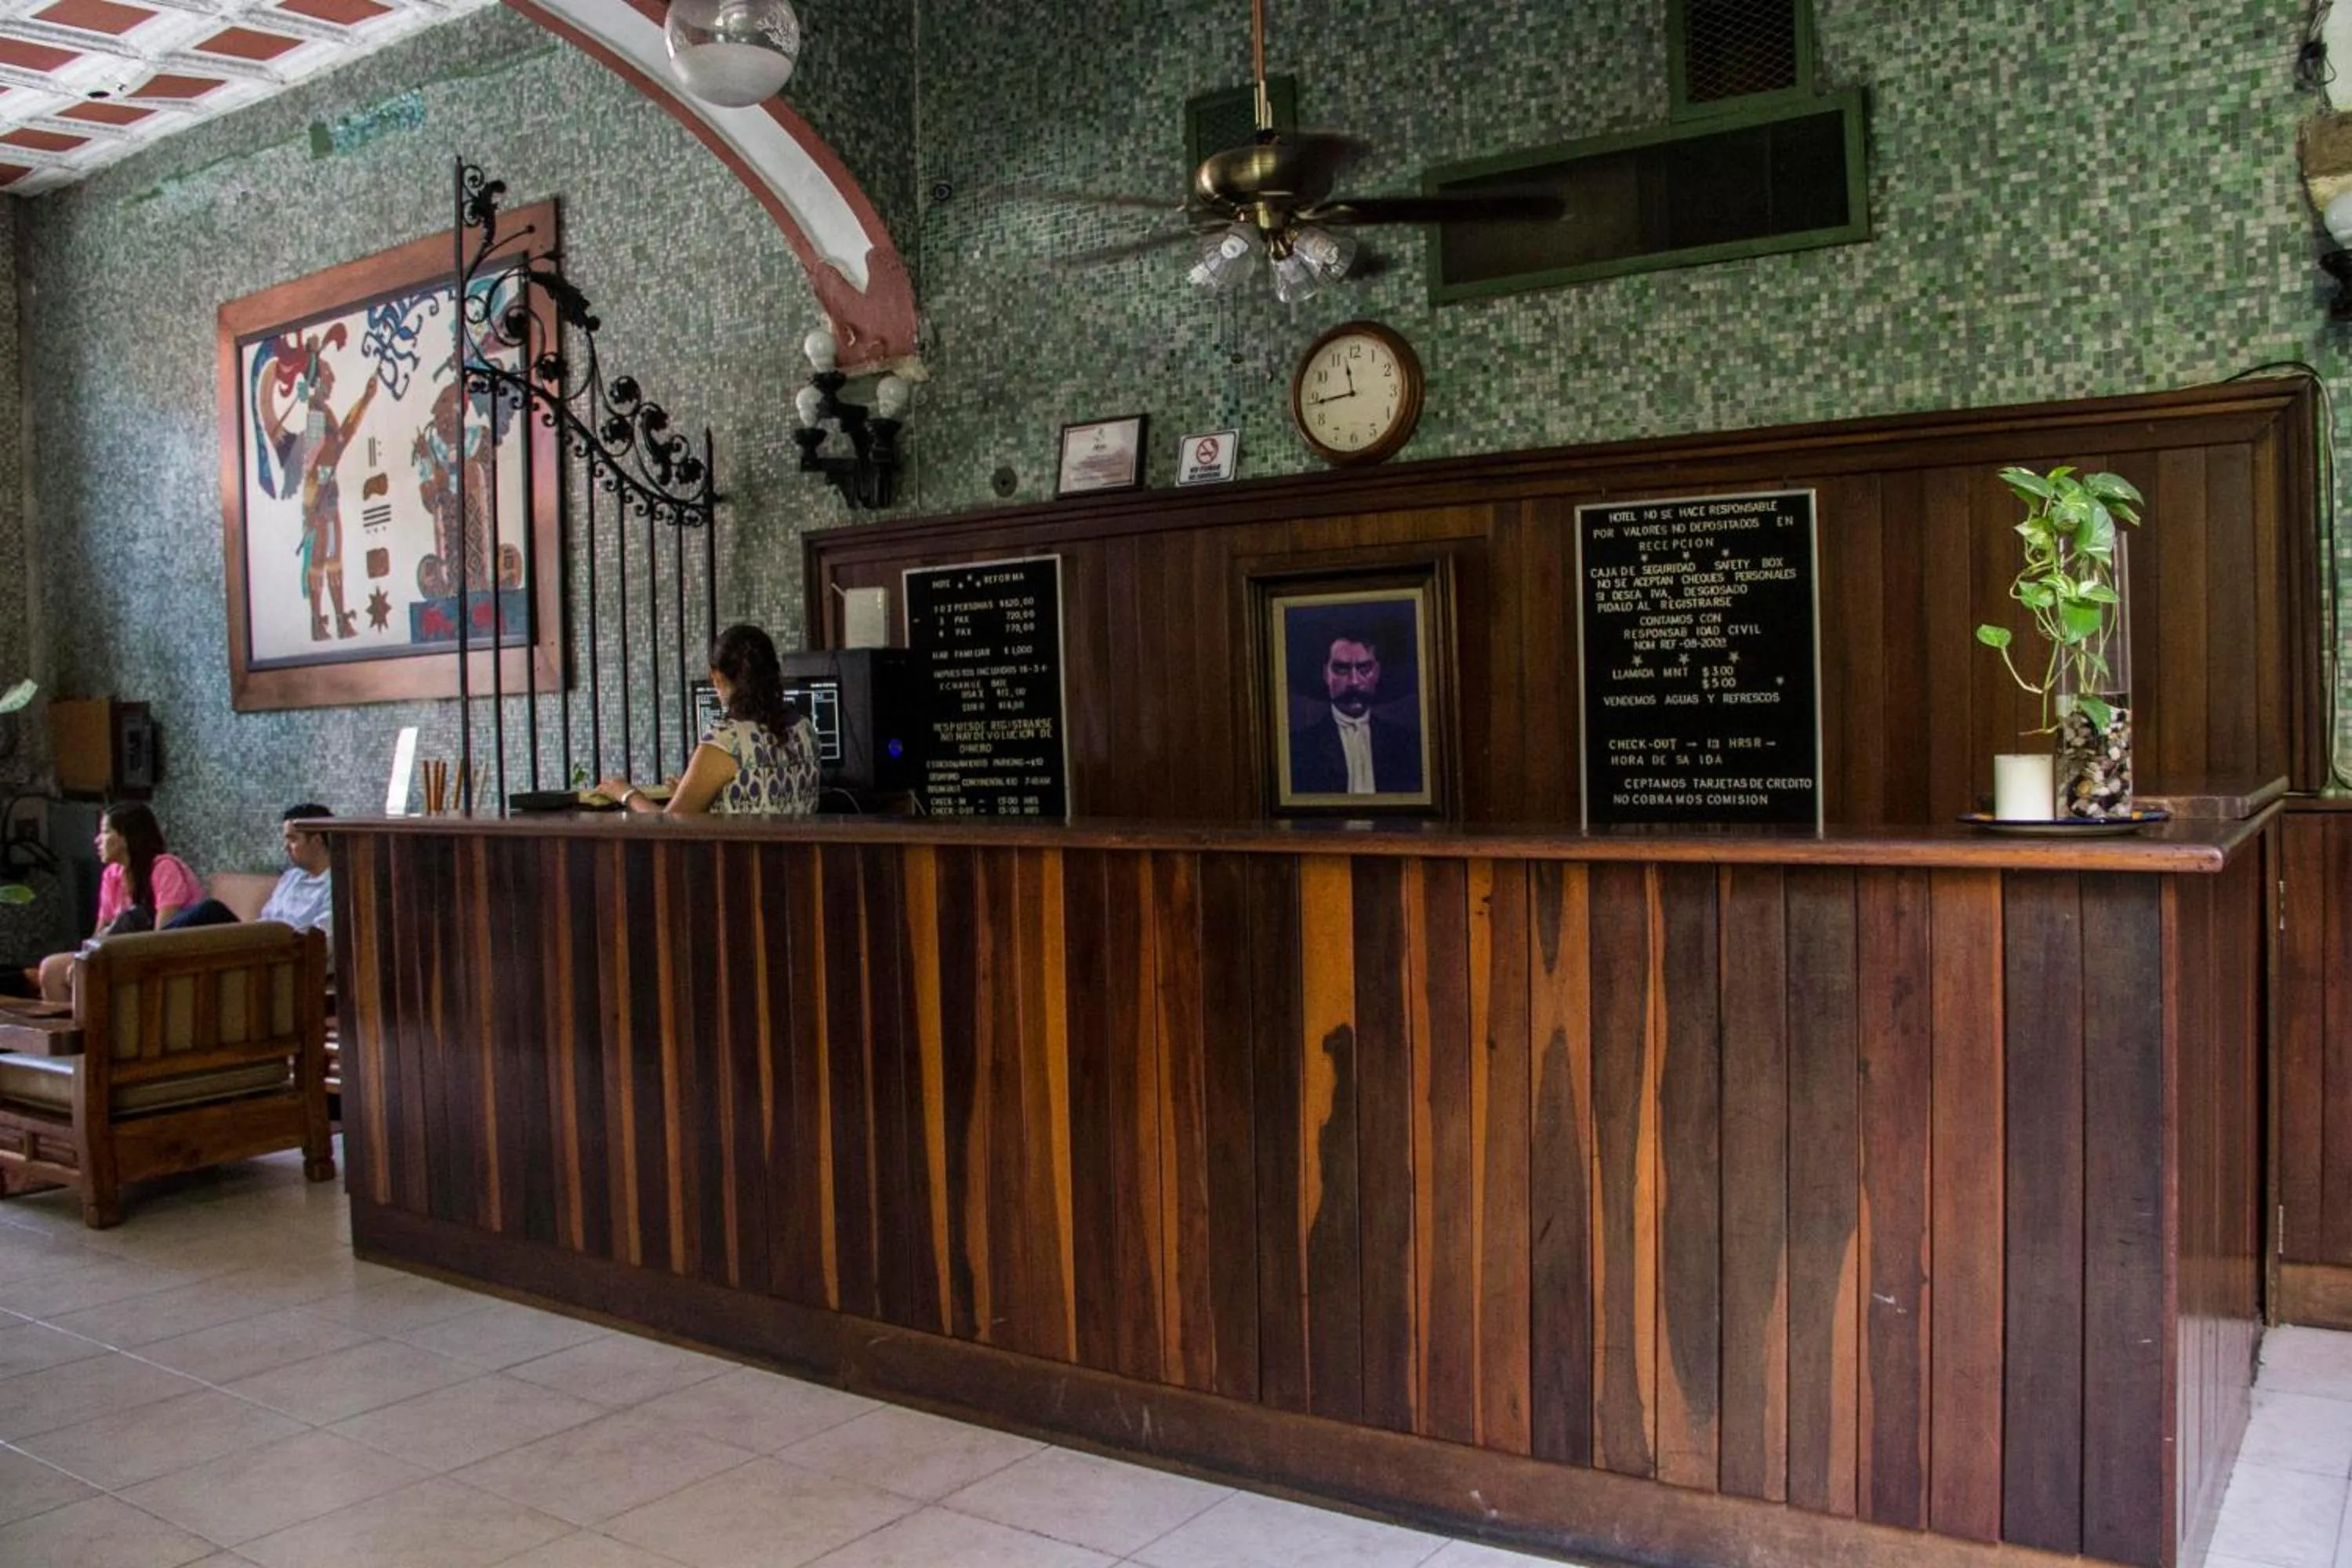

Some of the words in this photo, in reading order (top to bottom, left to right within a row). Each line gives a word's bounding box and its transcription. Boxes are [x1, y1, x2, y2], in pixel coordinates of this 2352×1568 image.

[1348, 343, 1362, 359] 12
[1331, 353, 1341, 368] 11
[1383, 363, 1392, 378] 2
[1389, 383, 1399, 398] 3
[1317, 412, 1327, 427] 8
[1349, 431, 1359, 445] 6
[1608, 511, 1637, 523] HOTEL
[1643, 509, 1657, 520] NO
[1661, 508, 1673, 519] SE
[1679, 506, 1706, 517] HACE
[1708, 500, 1778, 515] RESPONSABLE
[1592, 528, 1614, 539] POR
[1623, 524, 1668, 537] VALORES
[1671, 522, 1686, 534] NO
[1690, 517, 1760, 532] DEPOSITADOS
[1777, 515, 1794, 528] EN
[1639, 537, 1714, 551] RECEPCION
[1590, 568, 1617, 578] CAJA
[1621, 565, 1636, 576] DE
[1642, 561, 1696, 575] SEGURIDAD
[1714, 559, 1751, 570] SAFETY
[1762, 557, 1784, 568] BOX
[1597, 579, 1611, 590] NO
[1614, 577, 1628, 588] SE
[1633, 575, 1674, 587] ACEPTAN
[1735, 568, 1797, 582] PERSONALES
[1612, 589, 1642, 601] DESEA
[1637, 601, 1652, 612] AL
[1660, 596, 1733, 610] REGISTRARSE
[1639, 614, 1694, 626] CONTAMOS
[1699, 612, 1722, 623] CON
[1727, 624, 1762, 636] CIVIL
[1603, 694, 1657, 706] VENDEMOS
[1664, 693, 1700, 706] AGUAS
[1707, 693, 1715, 703] Y
[1722, 692, 1780, 704] REFRESCOS
[1608, 738, 1677, 750] CHECK-OUT
[1611, 754, 1645, 765] HORA
[1652, 754, 1667, 765] DE
[1693, 778, 1748, 789] TARJETAS
[1749, 778, 1763, 789] DE
[1766, 778, 1813, 789] CREDITO
[1613, 794, 1630, 805] NO
[1707, 793, 1769, 806] COMISION
